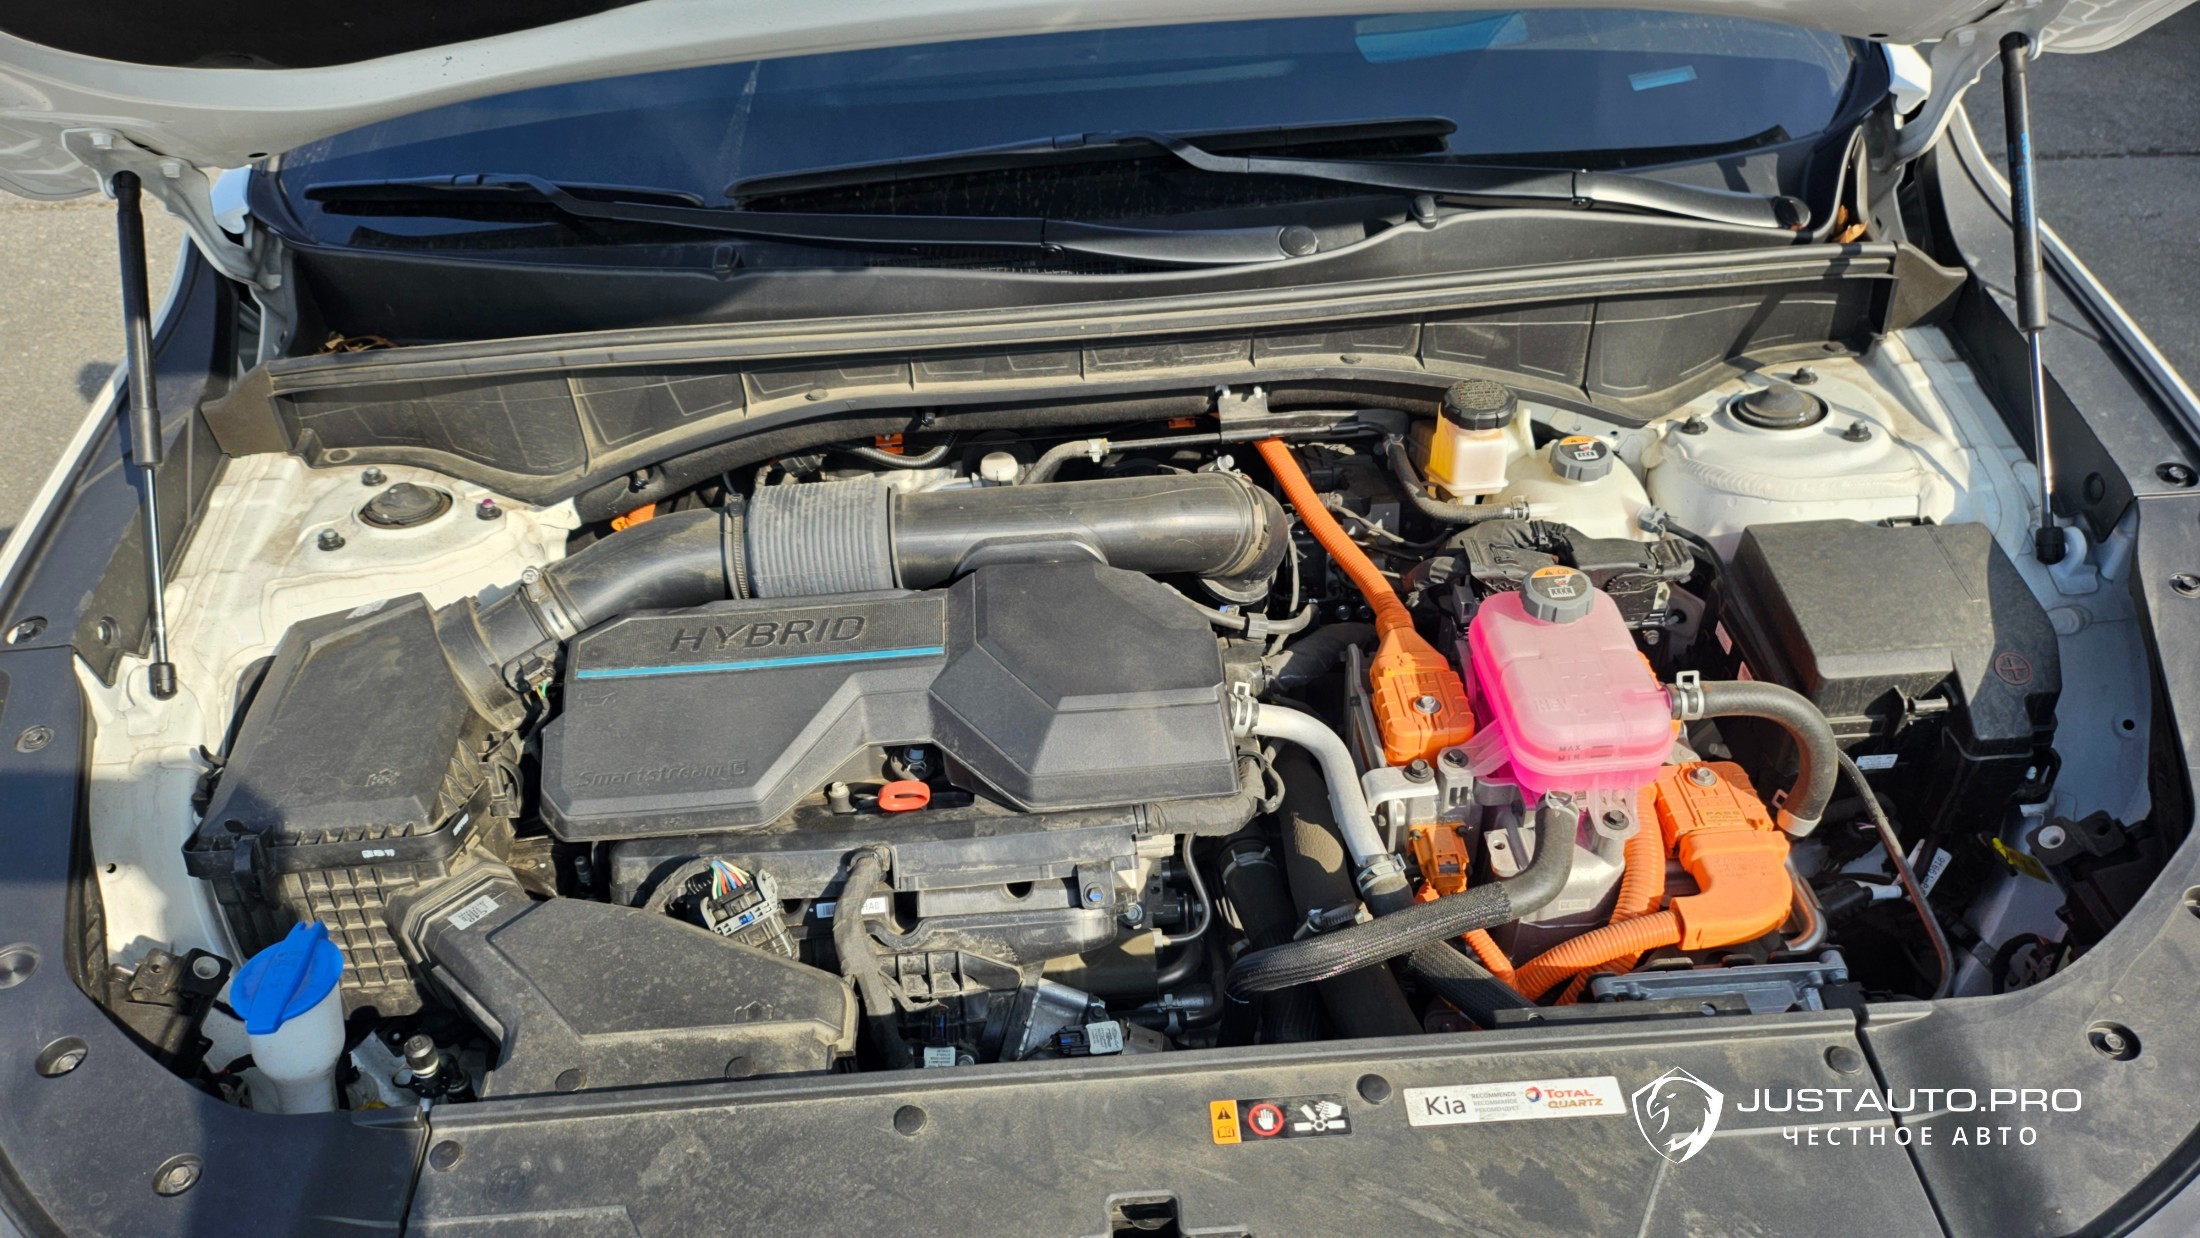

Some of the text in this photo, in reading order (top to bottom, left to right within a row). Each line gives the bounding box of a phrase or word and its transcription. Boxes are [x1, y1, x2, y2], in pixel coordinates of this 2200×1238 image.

[669, 615, 867, 653] HYBRID
[1471, 1091, 1516, 1099] RECOMMENDS
[1544, 1088, 1595, 1099] TOTAL
[1424, 1096, 1466, 1115] Kia
[1547, 1098, 1604, 1109] QUARTZ
